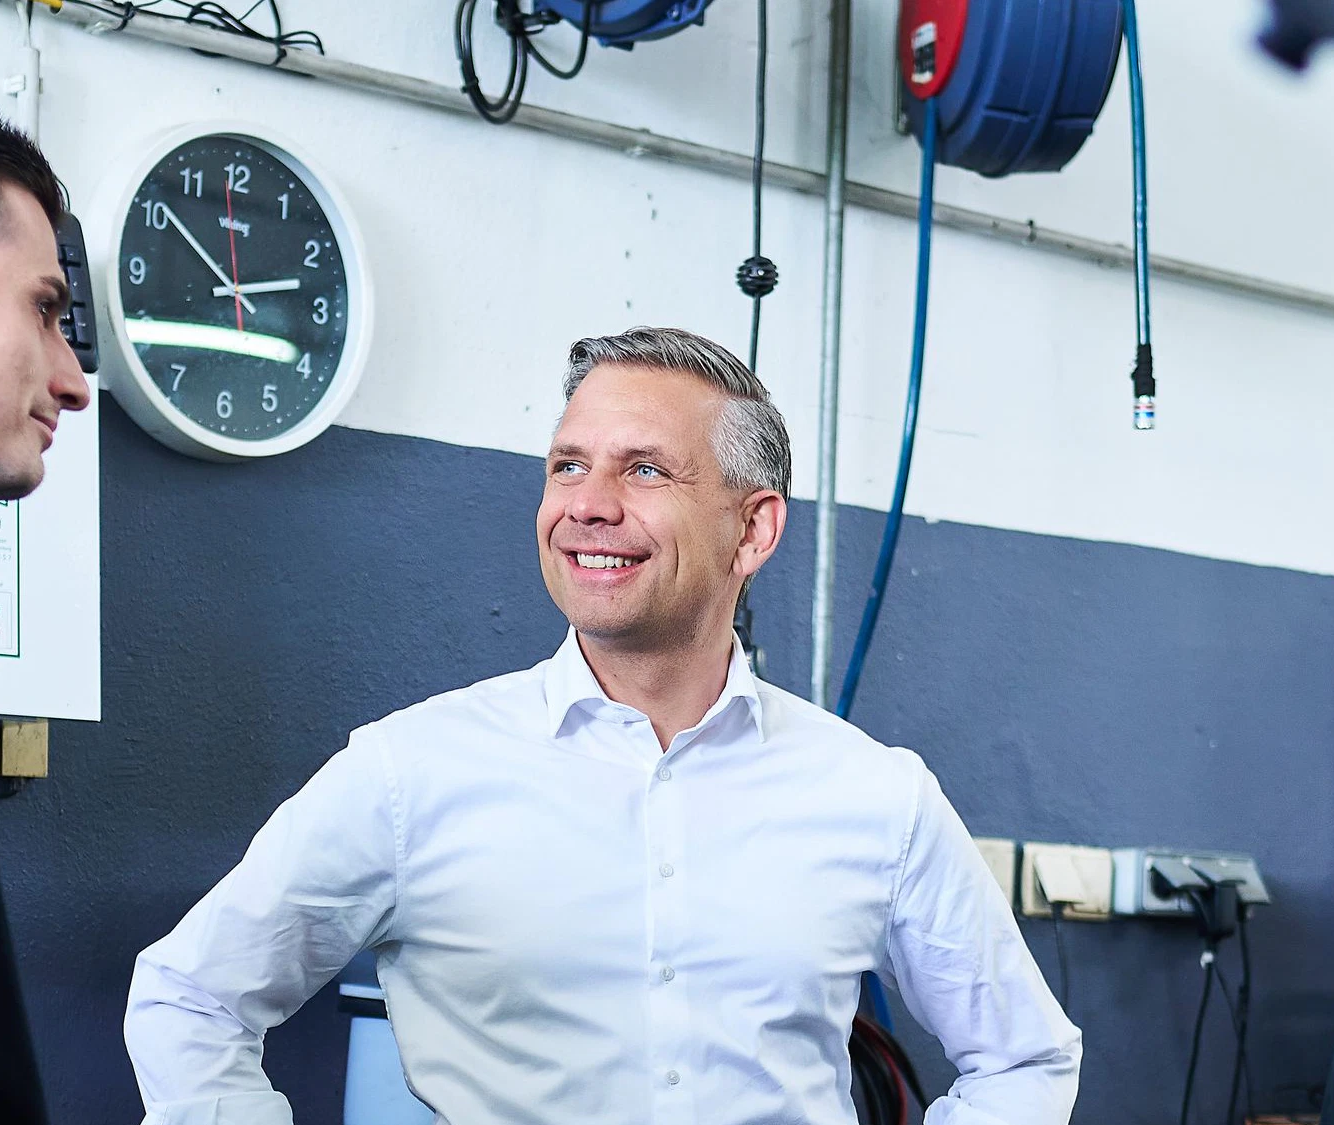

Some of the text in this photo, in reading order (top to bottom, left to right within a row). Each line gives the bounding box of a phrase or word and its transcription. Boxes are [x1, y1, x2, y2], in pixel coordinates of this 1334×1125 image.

[180, 167, 203, 198] 11
[224, 163, 251, 194] 12
[141, 199, 168, 230] 10
[277, 193, 289, 220] 1
[303, 240, 320, 268] 2
[129, 256, 146, 285] 9
[312, 297, 329, 325] 3
[170, 363, 187, 391] 7
[296, 353, 312, 379] 4
[216, 391, 233, 418] 6
[261, 384, 278, 412] 5
